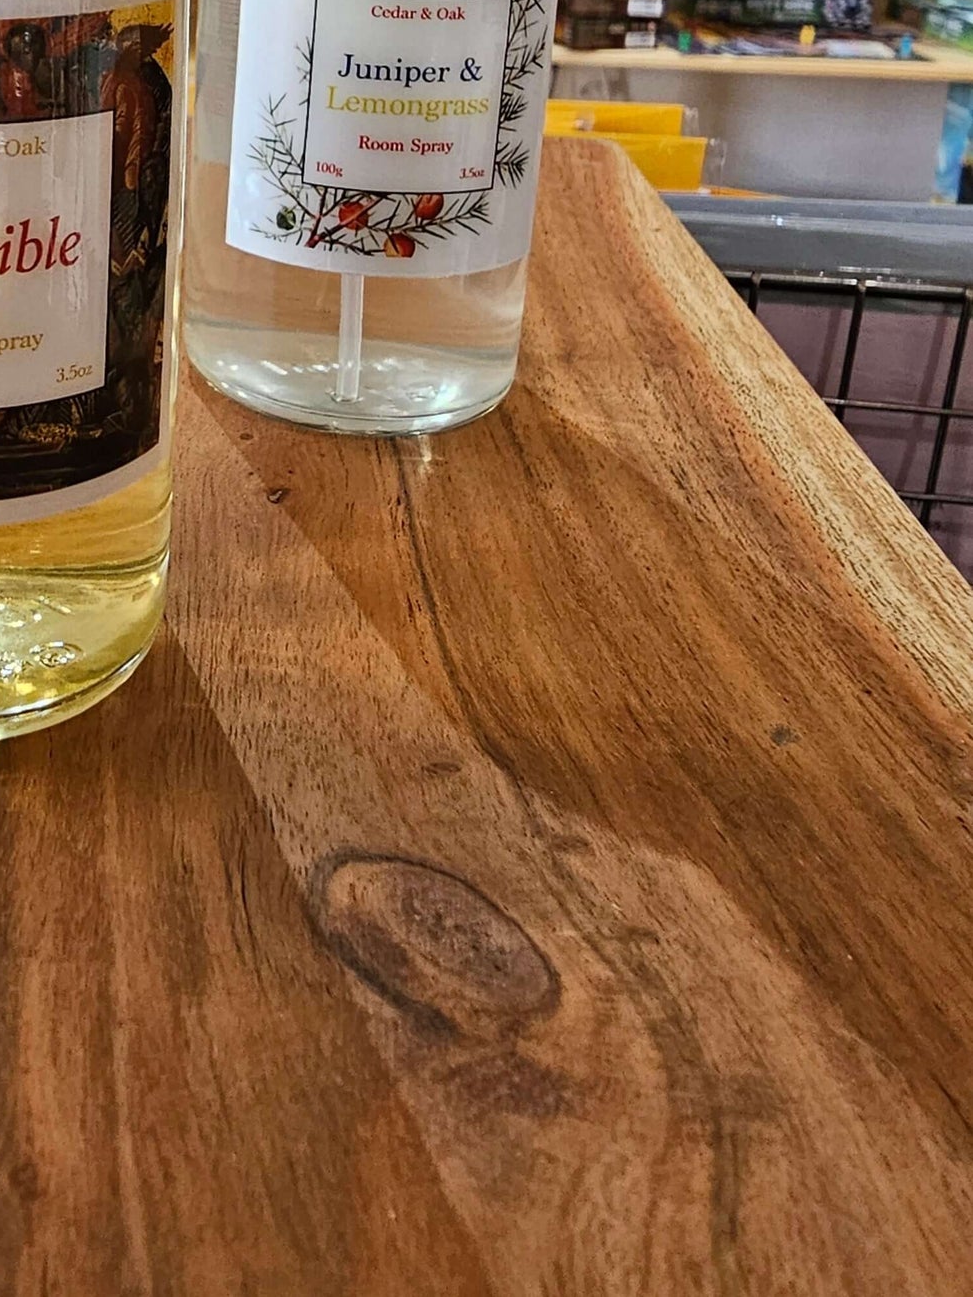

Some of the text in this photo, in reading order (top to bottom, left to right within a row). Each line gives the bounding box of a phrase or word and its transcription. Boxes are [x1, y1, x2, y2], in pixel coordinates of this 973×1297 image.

[370, 5, 467, 21] Cedar & Oak
[337, 53, 484, 88] Juniper &
[326, 85, 490, 123] Lemongrass
[4, 135, 47, 156] Oak
[358, 134, 455, 156] Room Spray
[315, 161, 344, 178] 100g
[55, 363, 94, 385] 3.5oz
